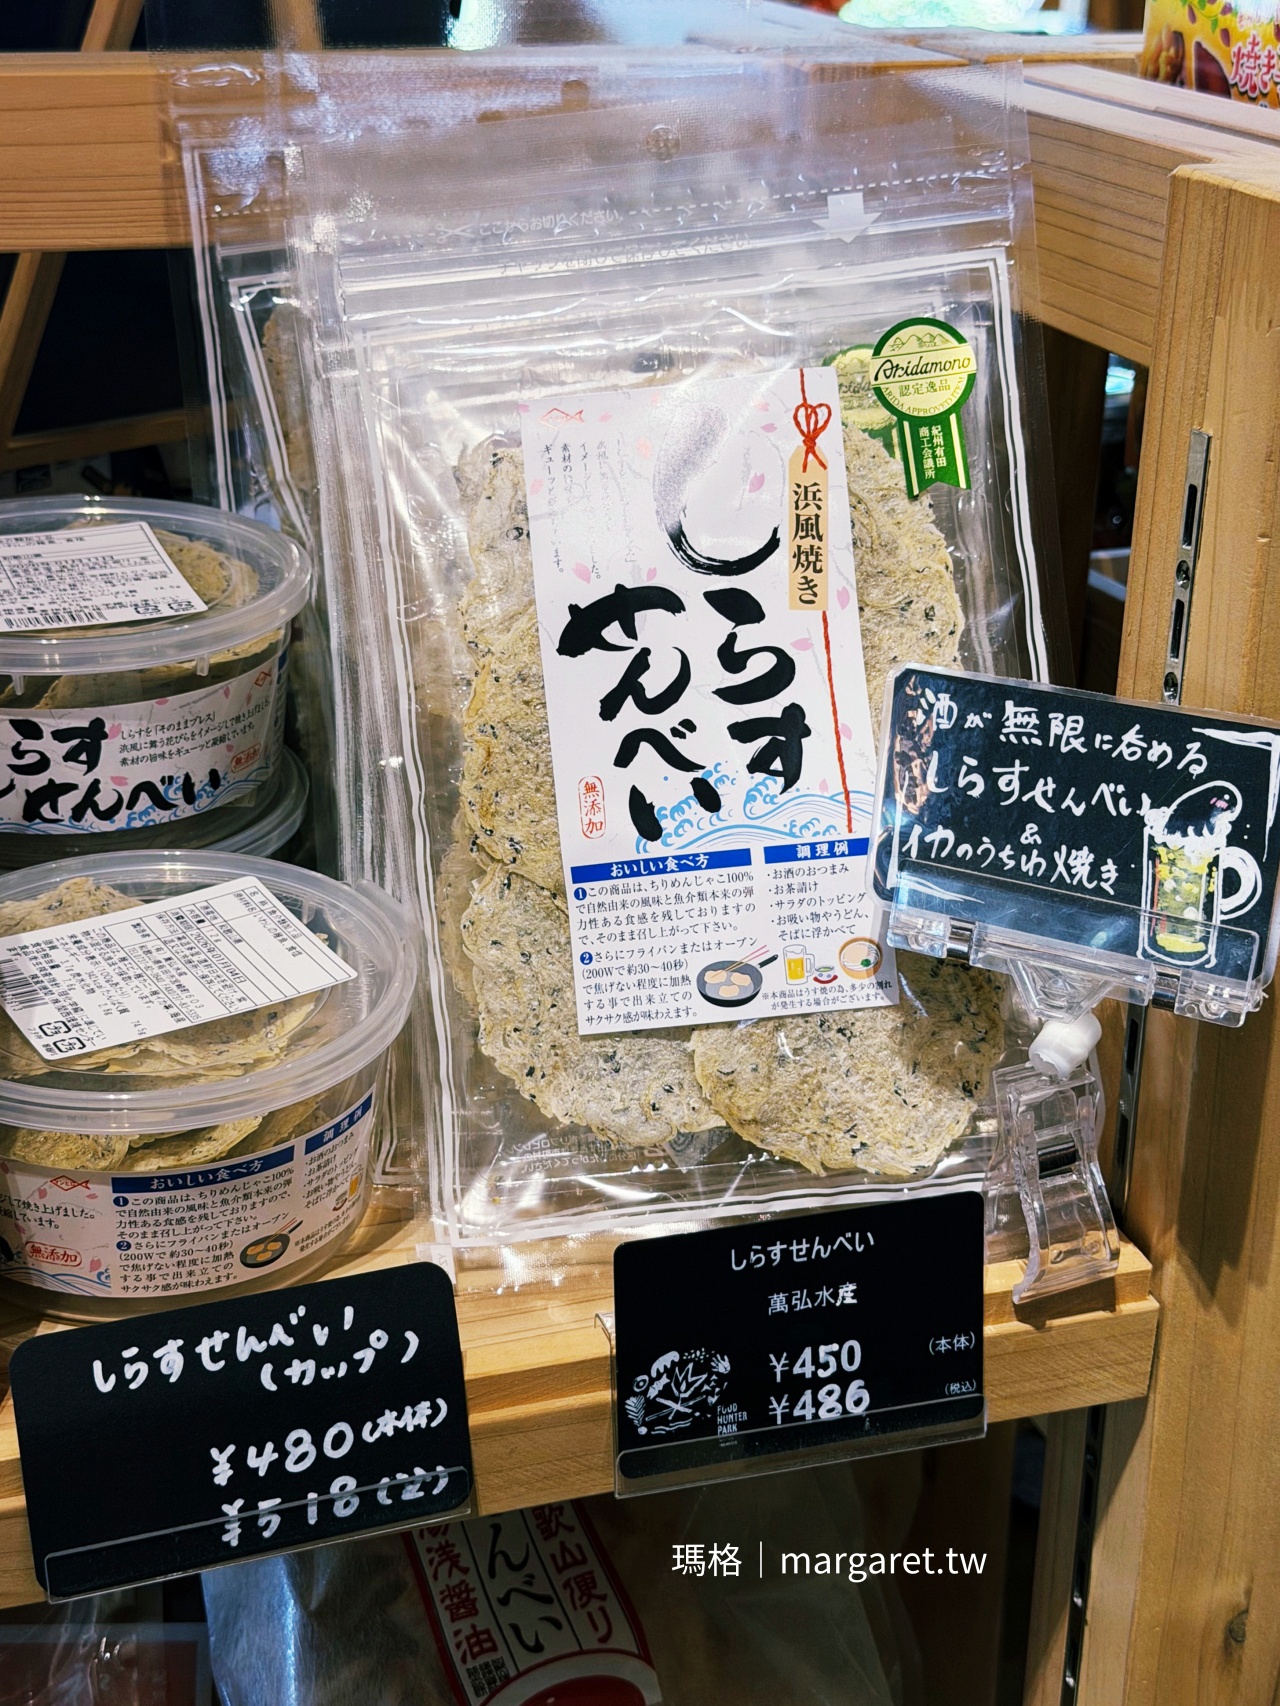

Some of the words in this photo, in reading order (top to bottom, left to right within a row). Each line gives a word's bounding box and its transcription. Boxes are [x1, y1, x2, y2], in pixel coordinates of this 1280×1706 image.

[874, 356, 971, 382] Aridamono
[882, 386, 905, 412] ARIDA
[905, 397, 954, 416] APPROVED
[898, 379, 950, 398] 認定逸品
[918, 426, 936, 480] 商工会議所
[931, 425, 947, 467] 紀州有田
[791, 482, 824, 606] 浜風焼き
[653, 401, 811, 796] しらす
[121, 711, 216, 741] しらすを「そのままプレス」
[556, 583, 722, 843] せんべい
[916, 688, 1209, 780] 酒が無限に呑める
[0, 717, 109, 790] らす
[22, 768, 221, 823] せんべい
[926, 750, 1153, 818] しらすせんべい
[582, 780, 604, 834] 無添加
[610, 853, 710, 877] おいしい食べ方
[796, 840, 849, 859] 調理例
[902, 824, 1120, 896] イカのうちわ焼き
[575, 886, 755, 915] で自然由来の風味と魚介類本来の弾
[576, 902, 756, 932] 力性ある食感を残しておりますの
[778, 923, 857, 942] そばに浮かべて
[217, 923, 244, 944] 和歌山県
[578, 921, 739, 946] で、そのまま召し上がって下さい。
[583, 974, 692, 995] で焦げない程度に加熱
[584, 991, 692, 1011] する事で出来立ての
[585, 1005, 698, 1027] サクサク感が味わえます。
[323, 1105, 363, 1143] 調理例
[151, 1159, 264, 1190] おいしい食べ方
[115, 1176, 293, 1218] で自然由来の風味と魚介類本来の弾
[115, 1191, 291, 1229] 力性ある食感を残しておりますので、
[117, 1214, 258, 1240] そのまま召し上がって下さい。
[30, 1244, 78, 1263] 無添加
[119, 1251, 235, 1272] で焦げない程度に加熱
[730, 1231, 875, 1271] しらすせんべい
[120, 1262, 233, 1283] する事で出来立ての
[121, 1272, 238, 1293] サクサク感が味わえます。
[768, 1281, 857, 1316] 萬弘水産
[93, 1305, 354, 1393] しらすせんべい
[929, 1331, 975, 1355] (本体)
[260, 1329, 420, 1391] (カップ)
[769, 1340, 862, 1383] ¥450
[769, 1379, 870, 1425] ¥486
[944, 1379, 977, 1396] (税込)
[717, 1411, 748, 1425] HUNTER
[717, 1423, 738, 1436] PARK
[210, 1421, 354, 1486] ¥480
[221, 1476, 360, 1547] ¥518
[488, 1522, 563, 1654] んべい
